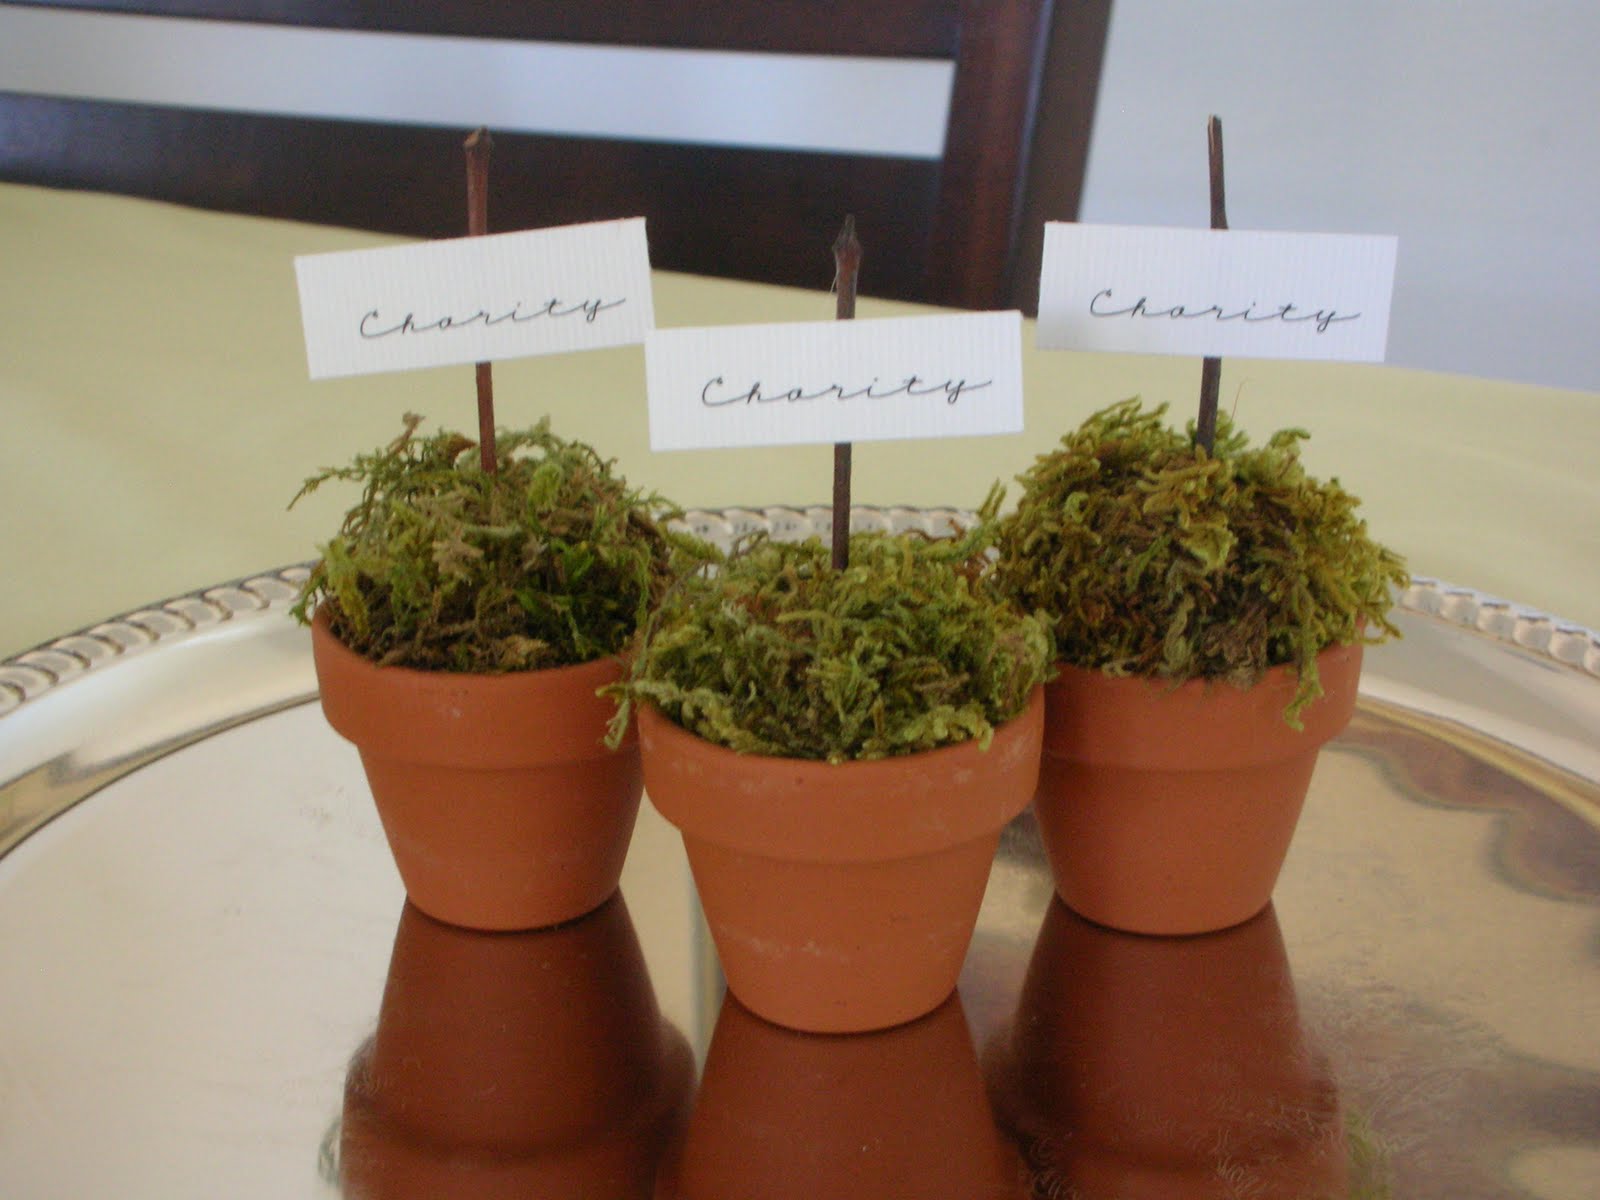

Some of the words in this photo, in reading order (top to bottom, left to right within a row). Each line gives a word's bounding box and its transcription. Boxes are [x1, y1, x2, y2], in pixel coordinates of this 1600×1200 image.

[359, 298, 627, 339] Charity
[1089, 288, 1361, 334] Charity
[701, 375, 993, 408] Charity
